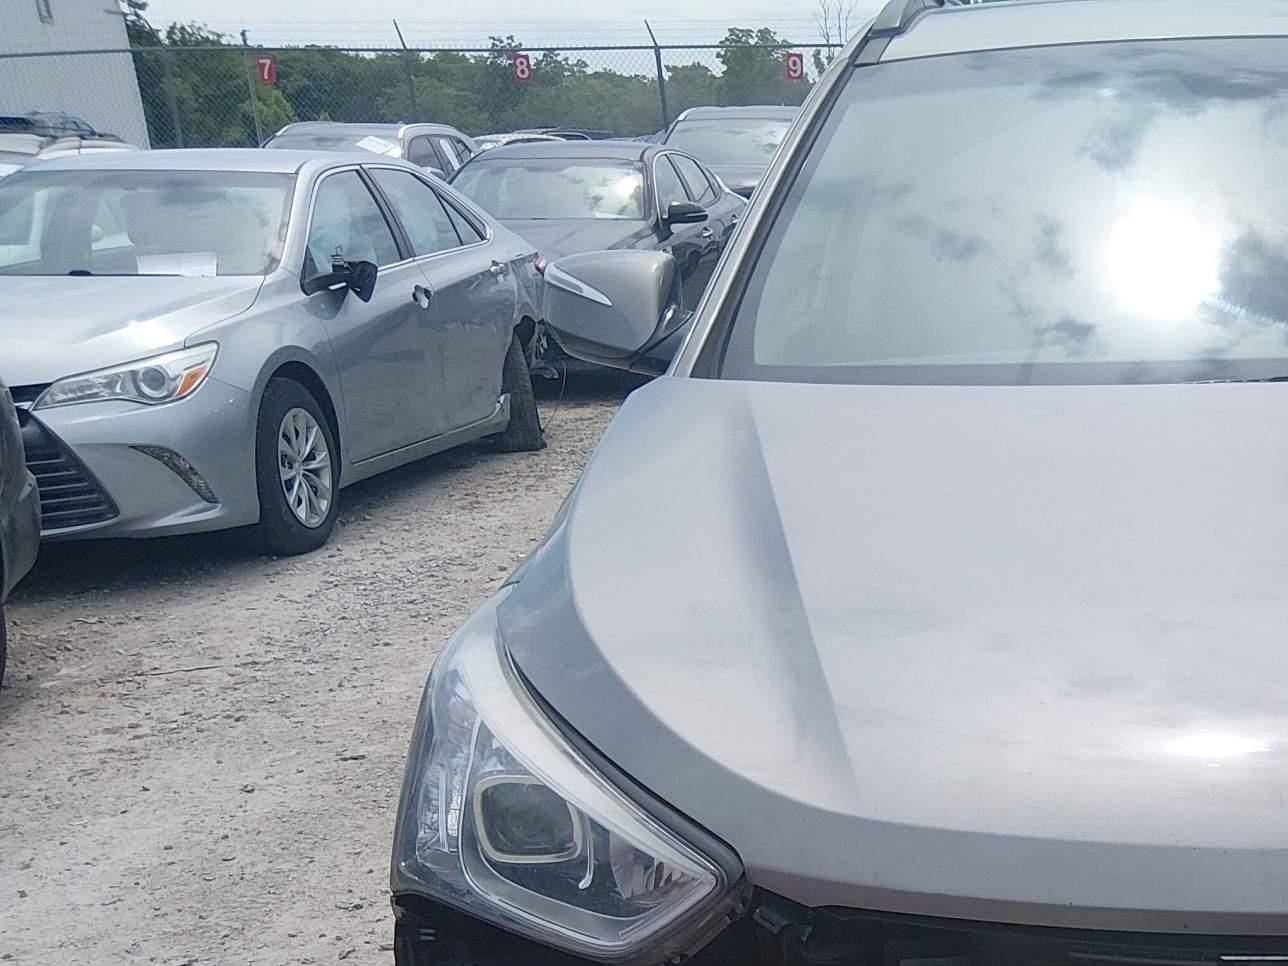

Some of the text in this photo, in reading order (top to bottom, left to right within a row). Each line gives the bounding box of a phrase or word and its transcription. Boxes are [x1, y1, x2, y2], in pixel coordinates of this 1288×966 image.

[258, 58, 271, 80] 7
[516, 57, 529, 79] 8
[788, 56, 801, 78] 9
